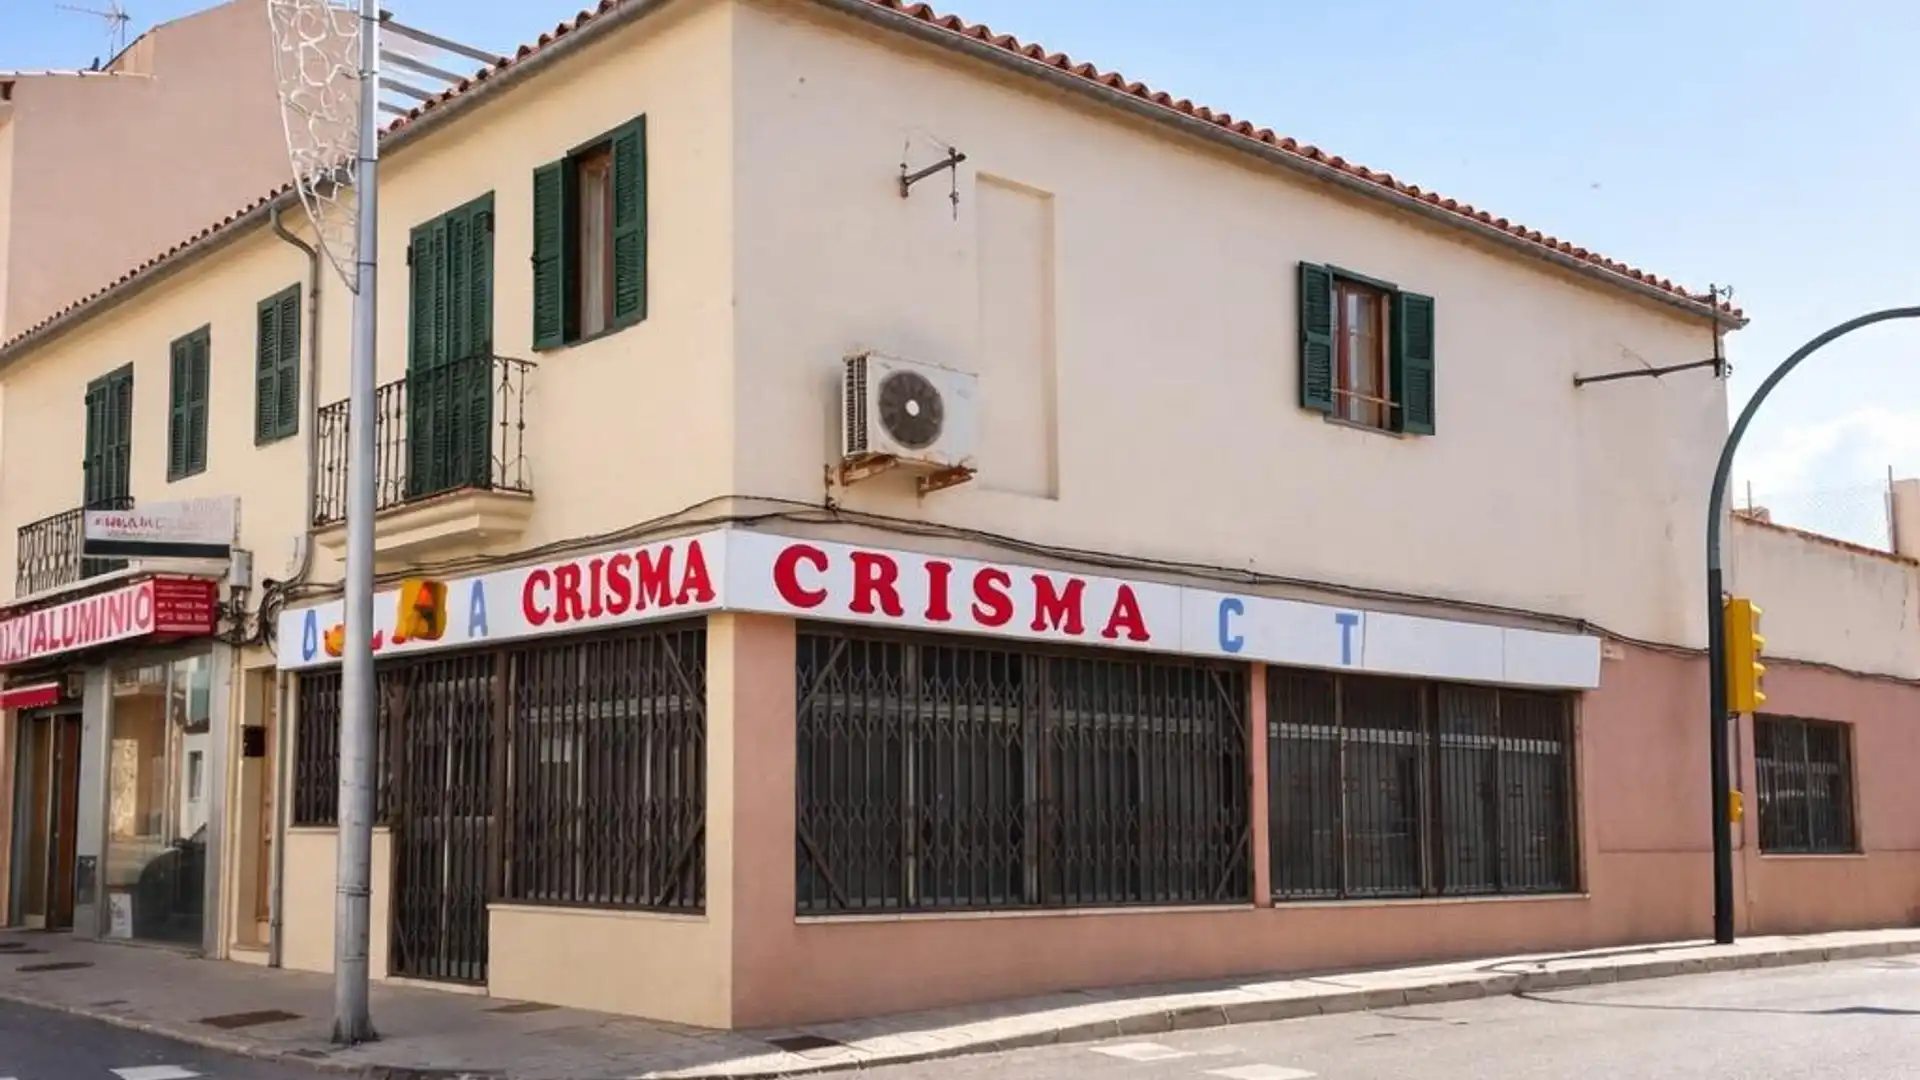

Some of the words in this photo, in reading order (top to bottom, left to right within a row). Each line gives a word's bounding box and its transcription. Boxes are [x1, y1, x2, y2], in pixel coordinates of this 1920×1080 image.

[522, 539, 716, 626] CRISMA
[773, 543, 1151, 642] CRISMA
[1219, 597, 1245, 653] C
[1335, 612, 1358, 665] T
